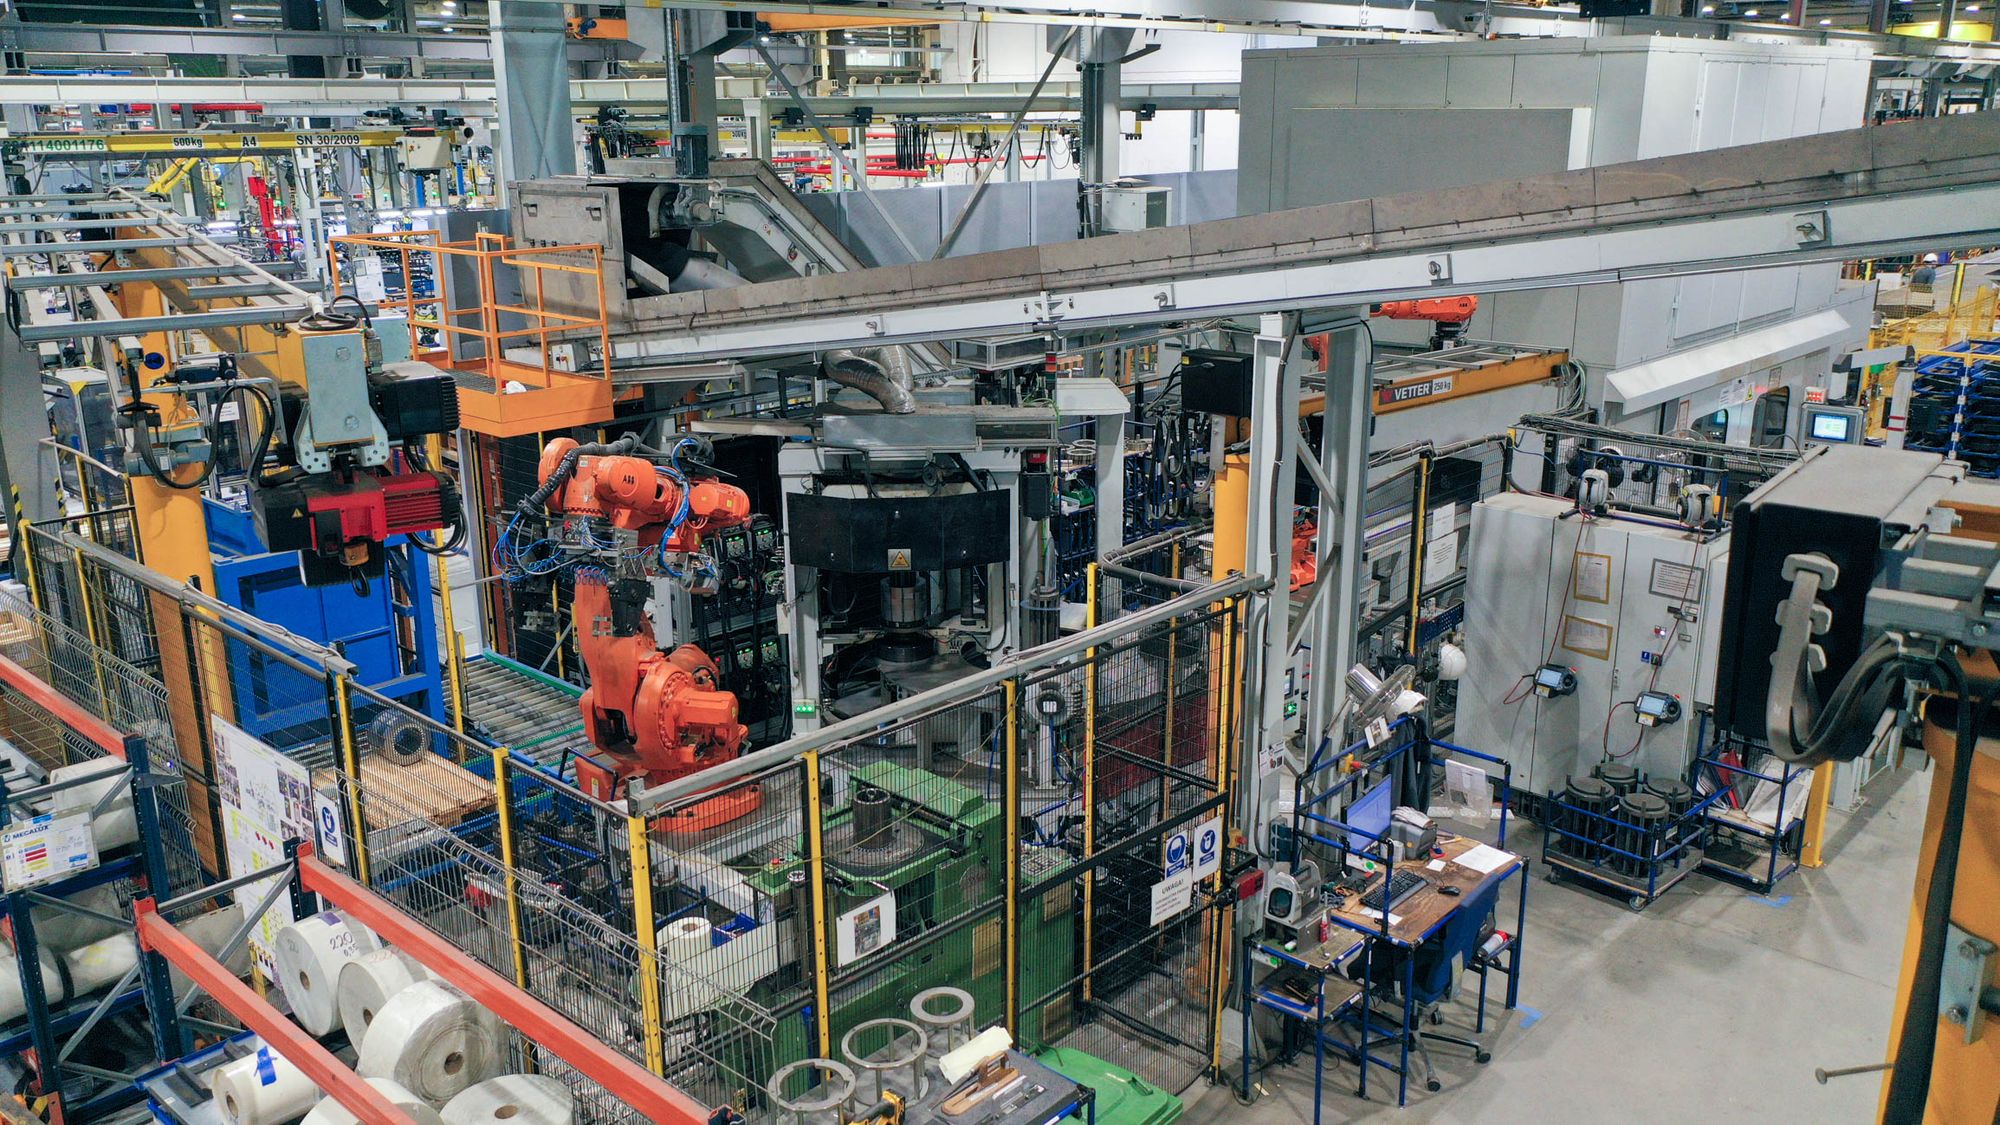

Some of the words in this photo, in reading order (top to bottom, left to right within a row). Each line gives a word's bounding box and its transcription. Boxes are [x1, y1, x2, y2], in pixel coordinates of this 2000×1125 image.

[173, 137, 203, 147] 500kg
[242, 136, 256, 147] A4
[296, 135, 313, 145] SN
[317, 134, 360, 146] 30/2009
[1395, 383, 1429, 400] VETTER
[623, 474, 635, 485] ABB
[13, 826, 49, 839] MECALUX
[329, 931, 353, 950] 220
